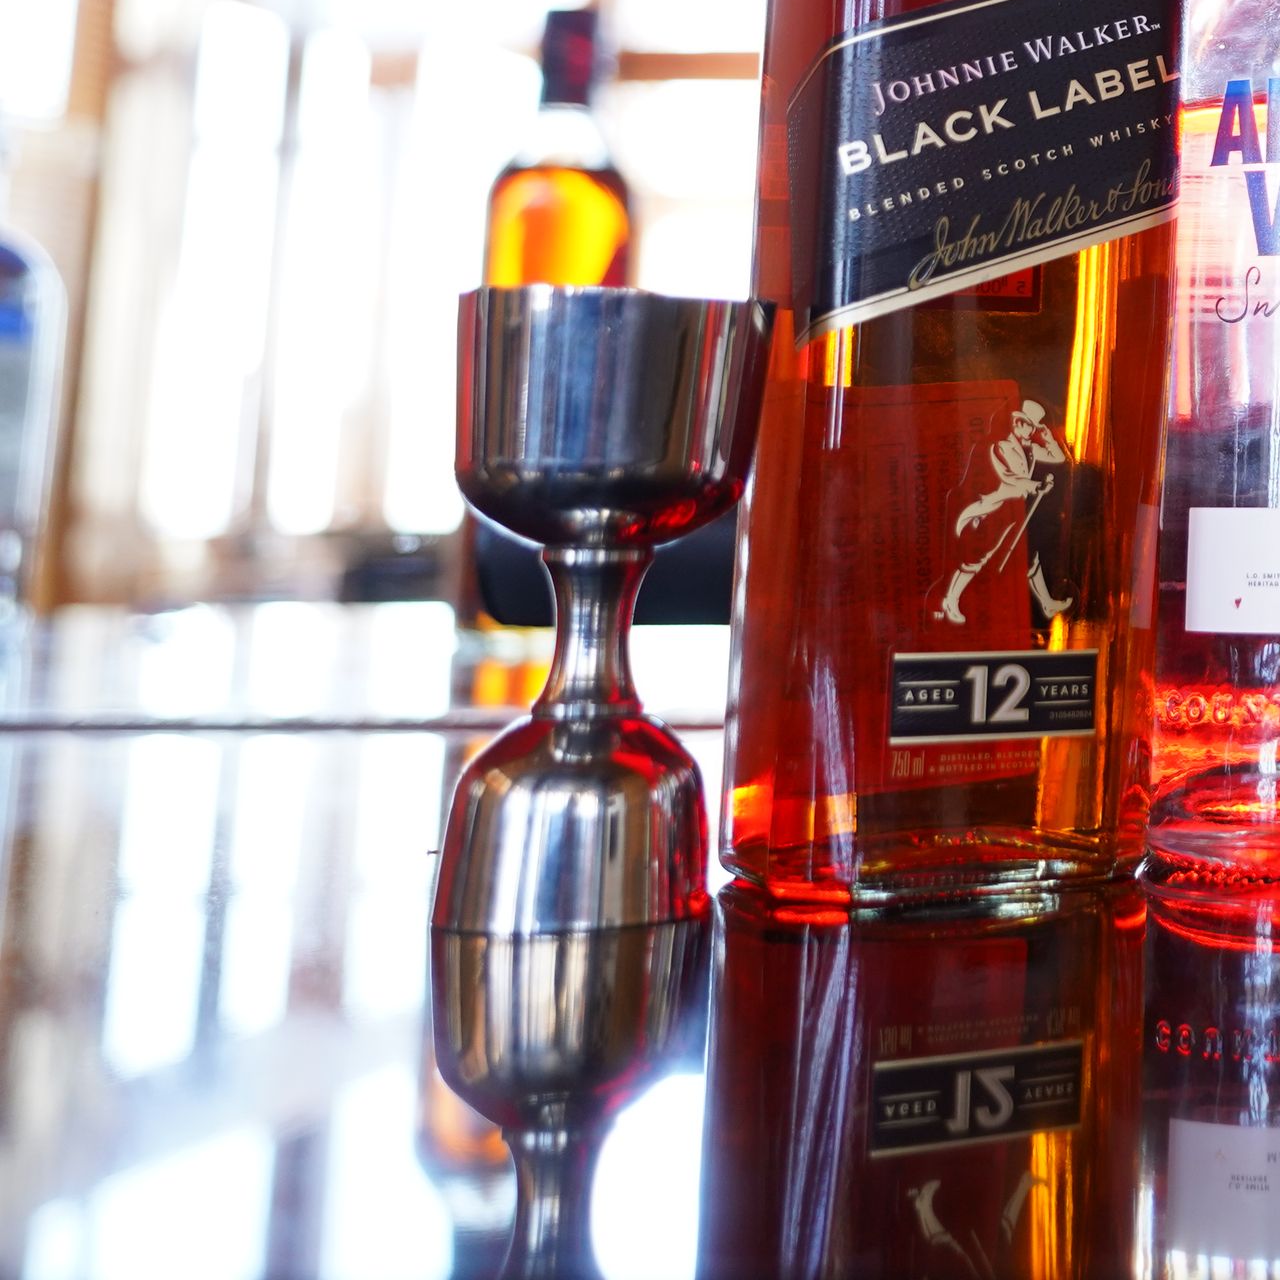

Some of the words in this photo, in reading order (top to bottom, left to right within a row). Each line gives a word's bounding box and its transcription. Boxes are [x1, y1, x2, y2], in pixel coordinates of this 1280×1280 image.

[837, 98, 1016, 175] BLACK
[1028, 55, 1179, 119] LABEL
[873, 51, 1018, 115] JOHNNIE
[849, 177, 964, 220] BLENDED
[982, 144, 1074, 180] SCOTCH
[1089, 113, 1173, 148] WHISKY
[908, 215, 998, 291] John
[1000, 184, 1102, 248] Walker
[904, 688, 955, 701] AGED
[963, 664, 1031, 724] 12
[1040, 684, 1089, 697] YEARS
[891, 751, 911, 777] 750
[912, 751, 925, 776] ml
